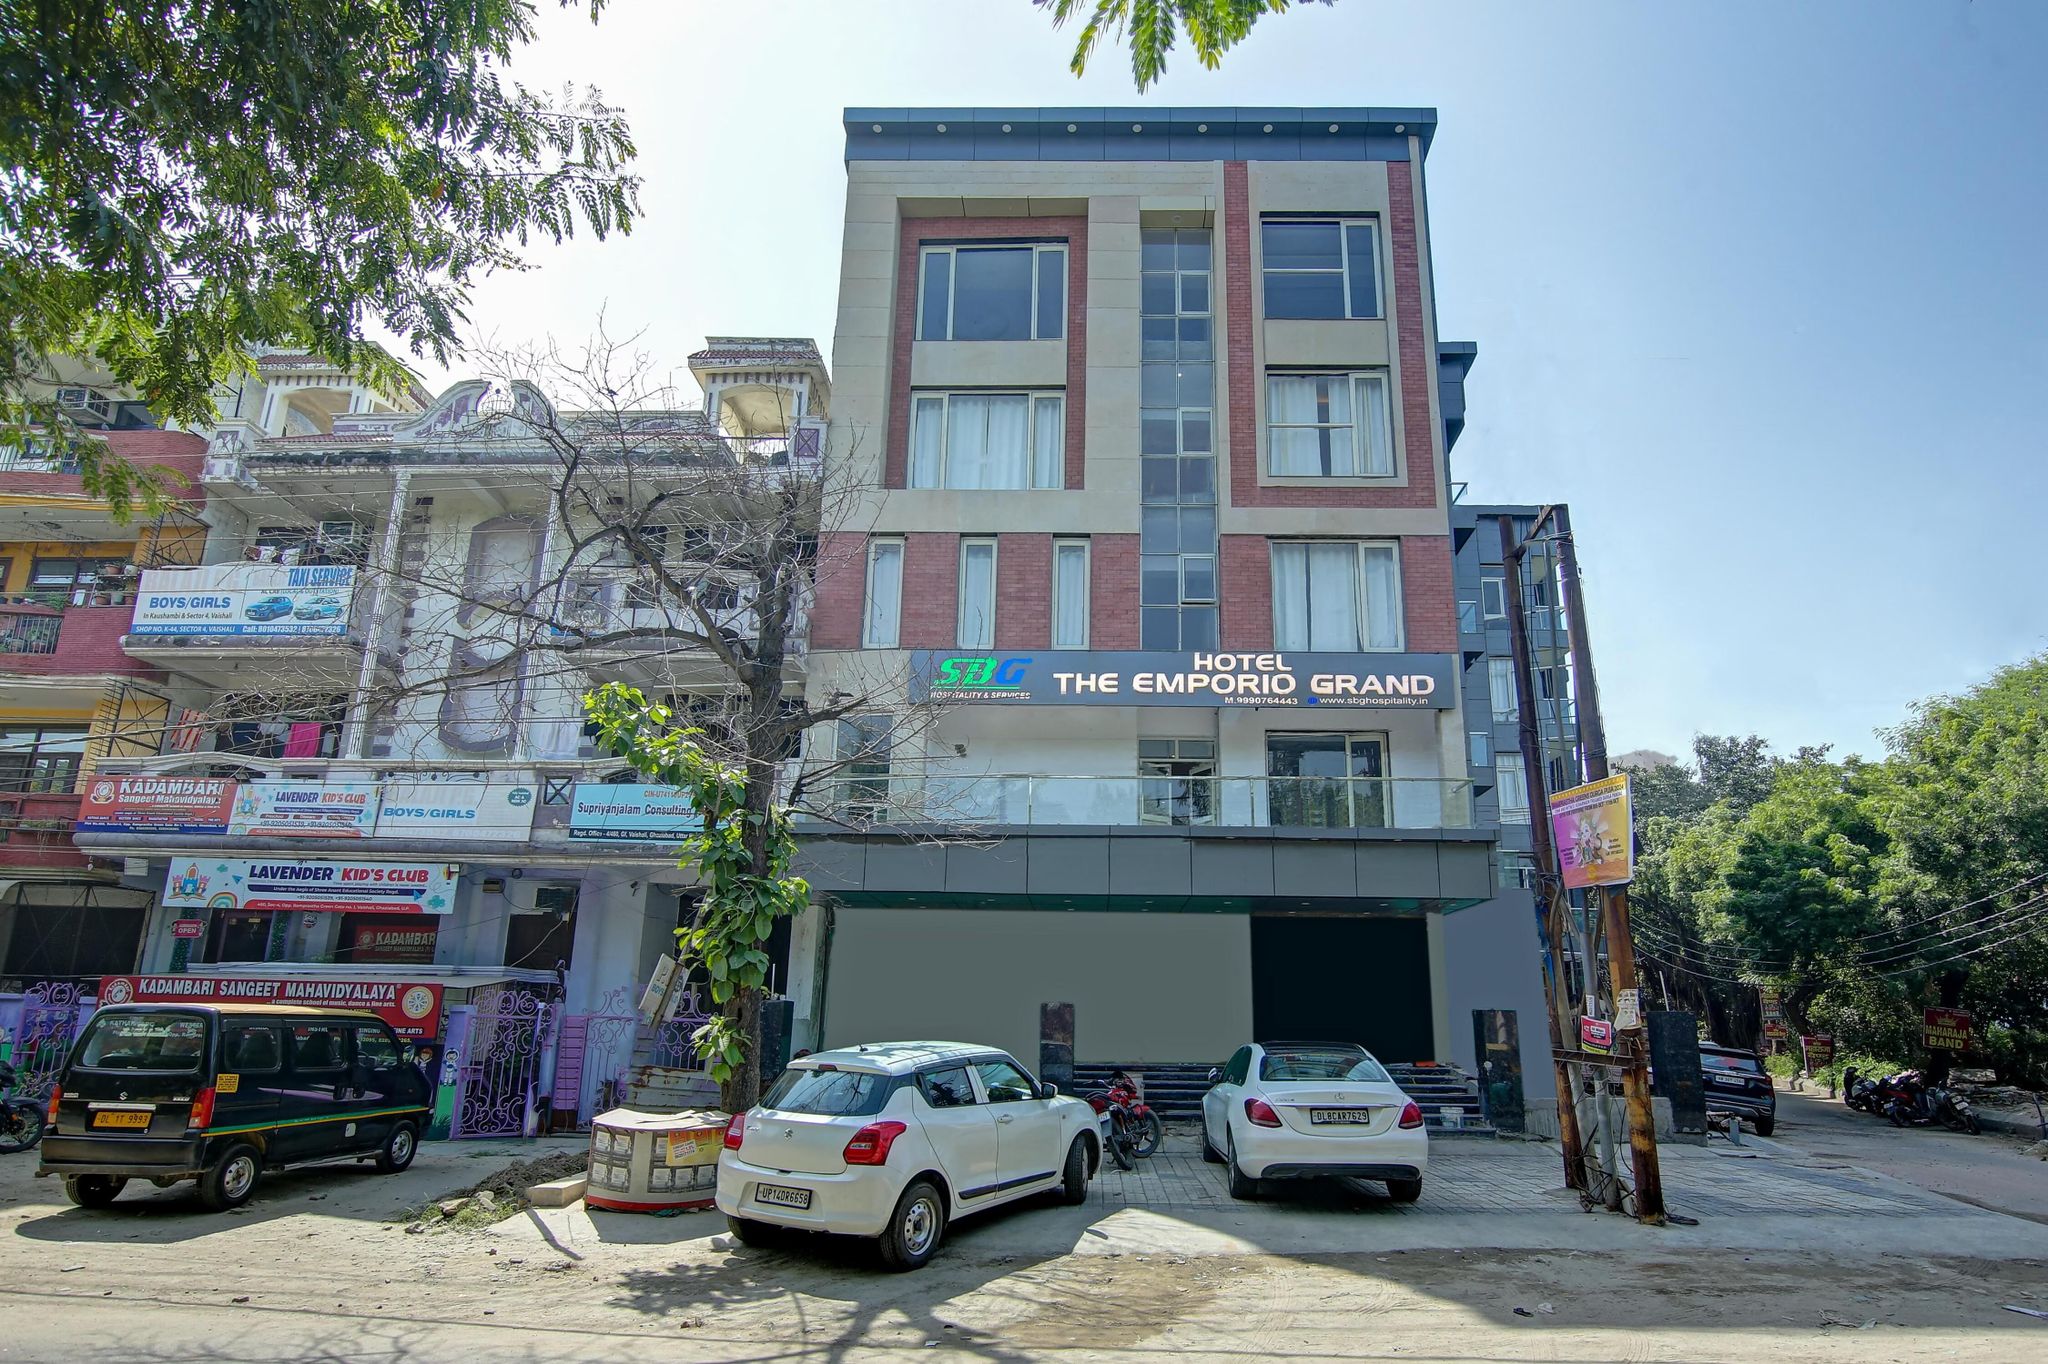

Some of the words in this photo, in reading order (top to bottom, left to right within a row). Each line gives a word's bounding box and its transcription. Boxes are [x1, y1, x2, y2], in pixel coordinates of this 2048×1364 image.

[288, 568, 309, 586] TAXI
[150, 597, 230, 608] BOYS/GIRLS
[1194, 652, 1292, 671] HOTEL
[936, 657, 1033, 684] SBG
[1053, 673, 1118, 695] THE
[1133, 673, 1296, 694] EMPORIO
[1311, 674, 1435, 695] GRAND
[1225, 697, 1297, 705] M.9990764443
[1320, 697, 1428, 706] www.sbghospitality.in
[120, 778, 224, 796] KADAMBARI
[118, 795, 154, 803] Sangeet
[276, 792, 318, 803] LAVENDER
[322, 793, 343, 803] KID'S
[345, 793, 366, 804] CLUB
[383, 808, 476, 818] BOYS/GIRLS
[578, 802, 640, 816] Supriyanjalam
[645, 804, 691, 817] Consulting
[249, 865, 334, 880] LAVENDER
[342, 868, 384, 881] KID'S
[387, 870, 429, 882] CLUB
[376, 932, 436, 945] KADAMBAR
[139, 979, 215, 995] KADAMBARI
[220, 982, 280, 996] SANGEET
[285, 982, 395, 1000] MAHAVIDYALAYA
[651, 984, 664, 996] BOYS
[1926, 1025, 1967, 1039] MAHARAJA
[1930, 1036, 1964, 1048] BAND
[100, 1116, 109, 1124] DL
[1317, 1112, 1366, 1120] DL8CAR7629
